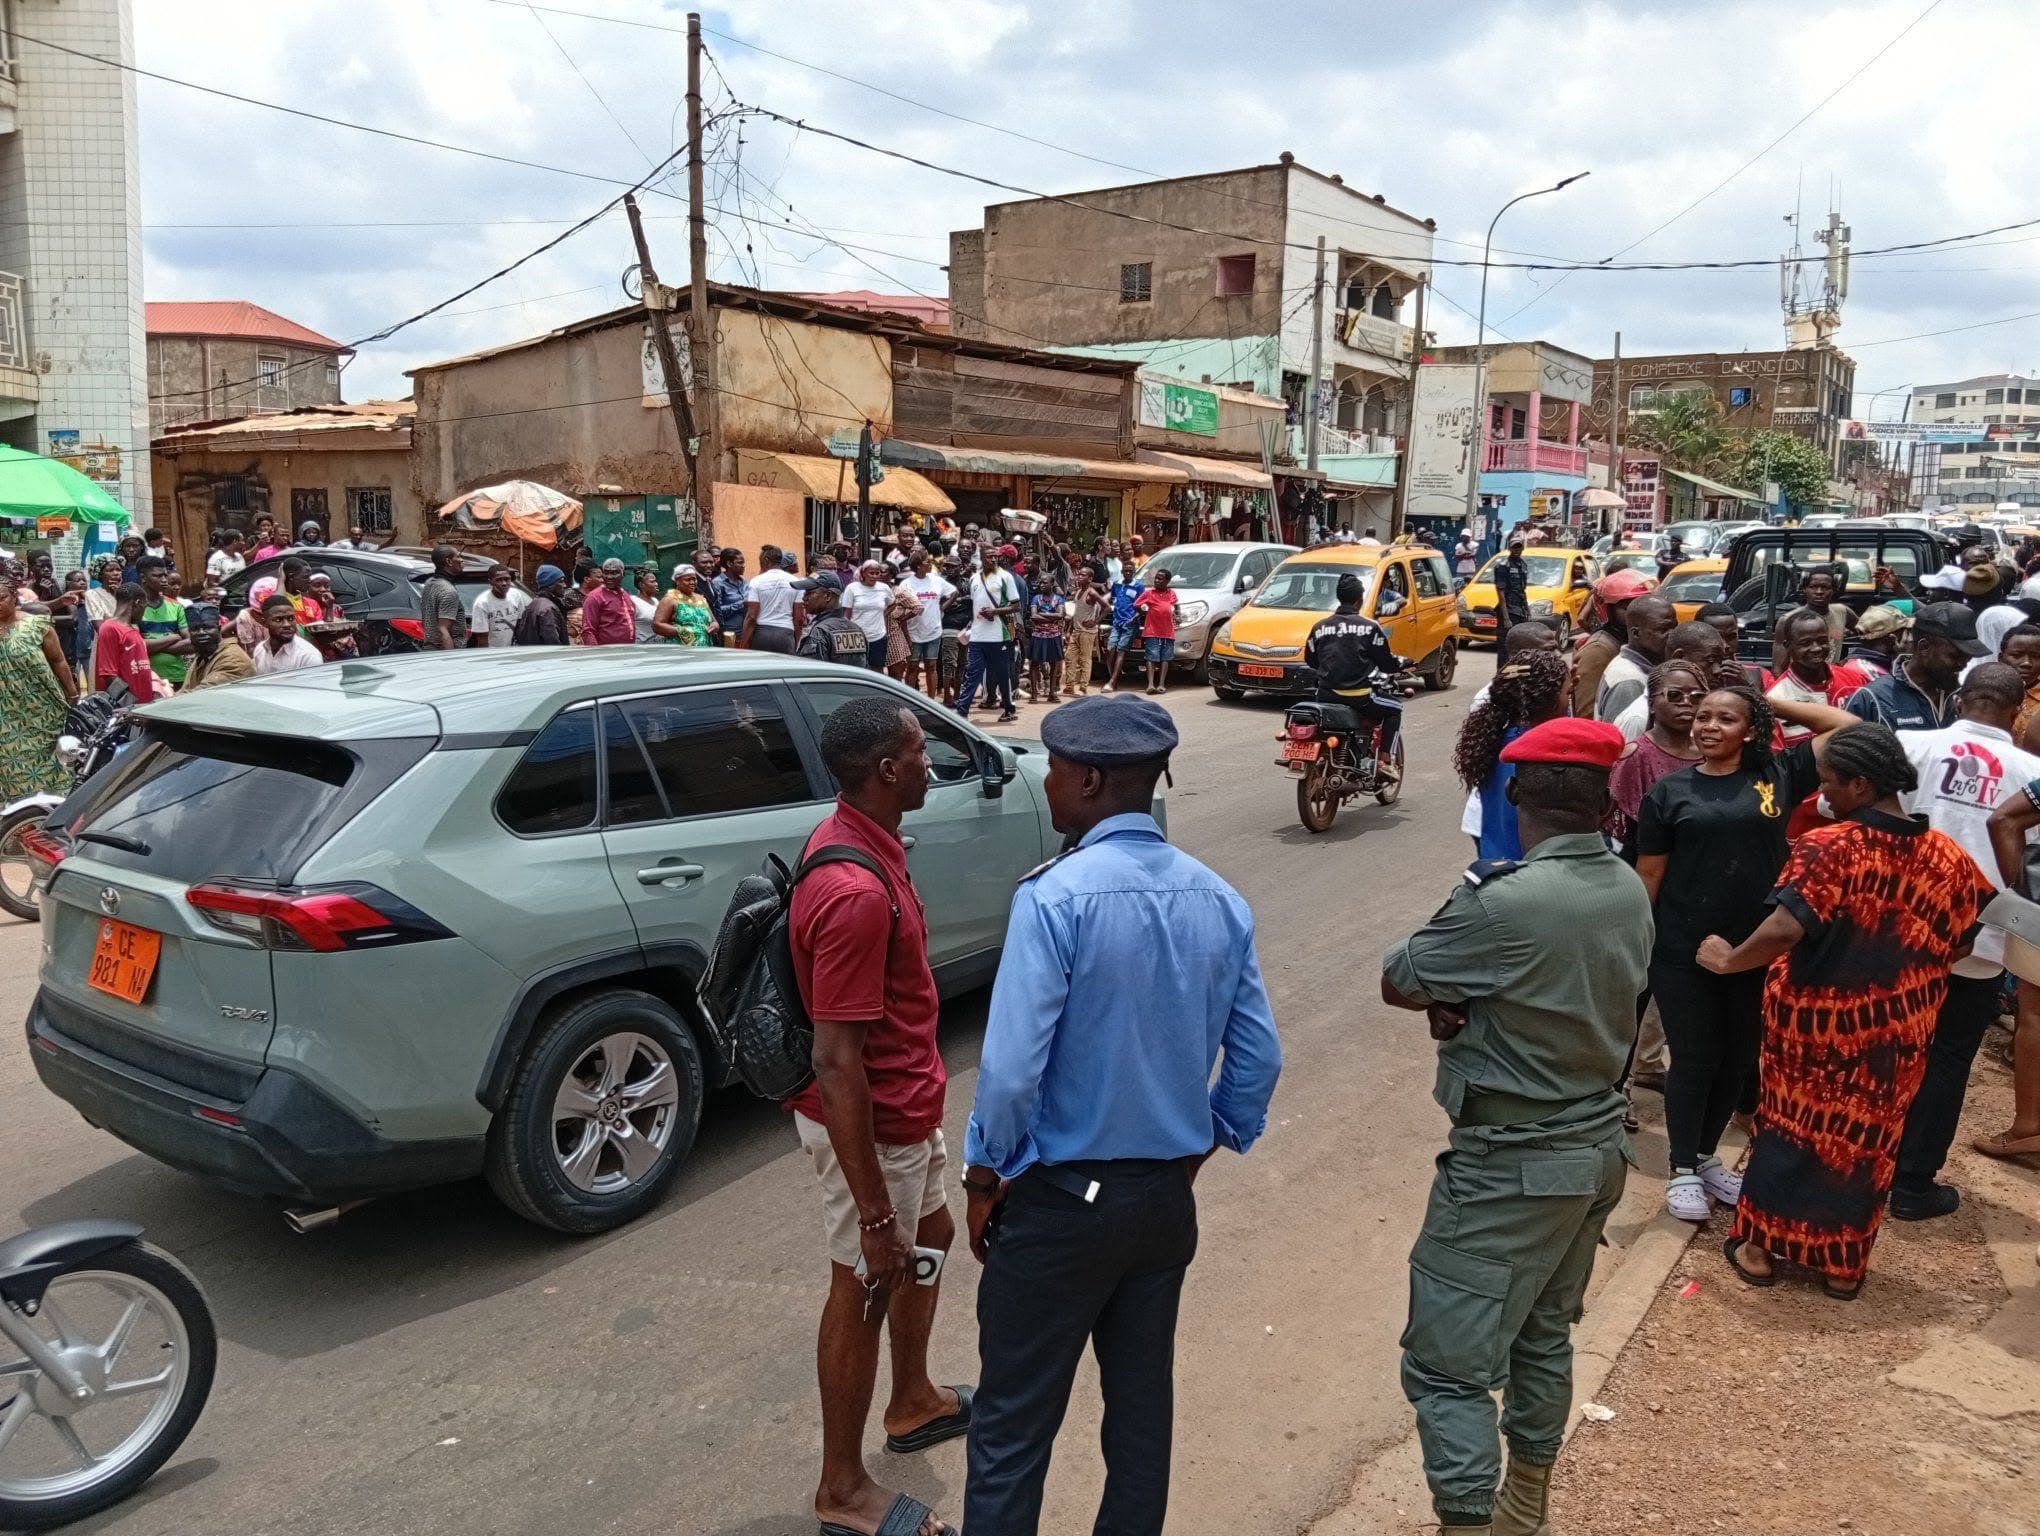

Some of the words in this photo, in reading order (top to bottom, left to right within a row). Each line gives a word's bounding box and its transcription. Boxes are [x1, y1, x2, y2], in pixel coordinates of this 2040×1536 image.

[1631, 362, 1704, 377] COMPLEXE
[1721, 358, 1806, 375] CARINGTON
[747, 471, 778, 488] GAZ
[835, 633, 865, 650] POLICE
[118, 928, 137, 961] CE
[92, 954, 121, 988] 981
